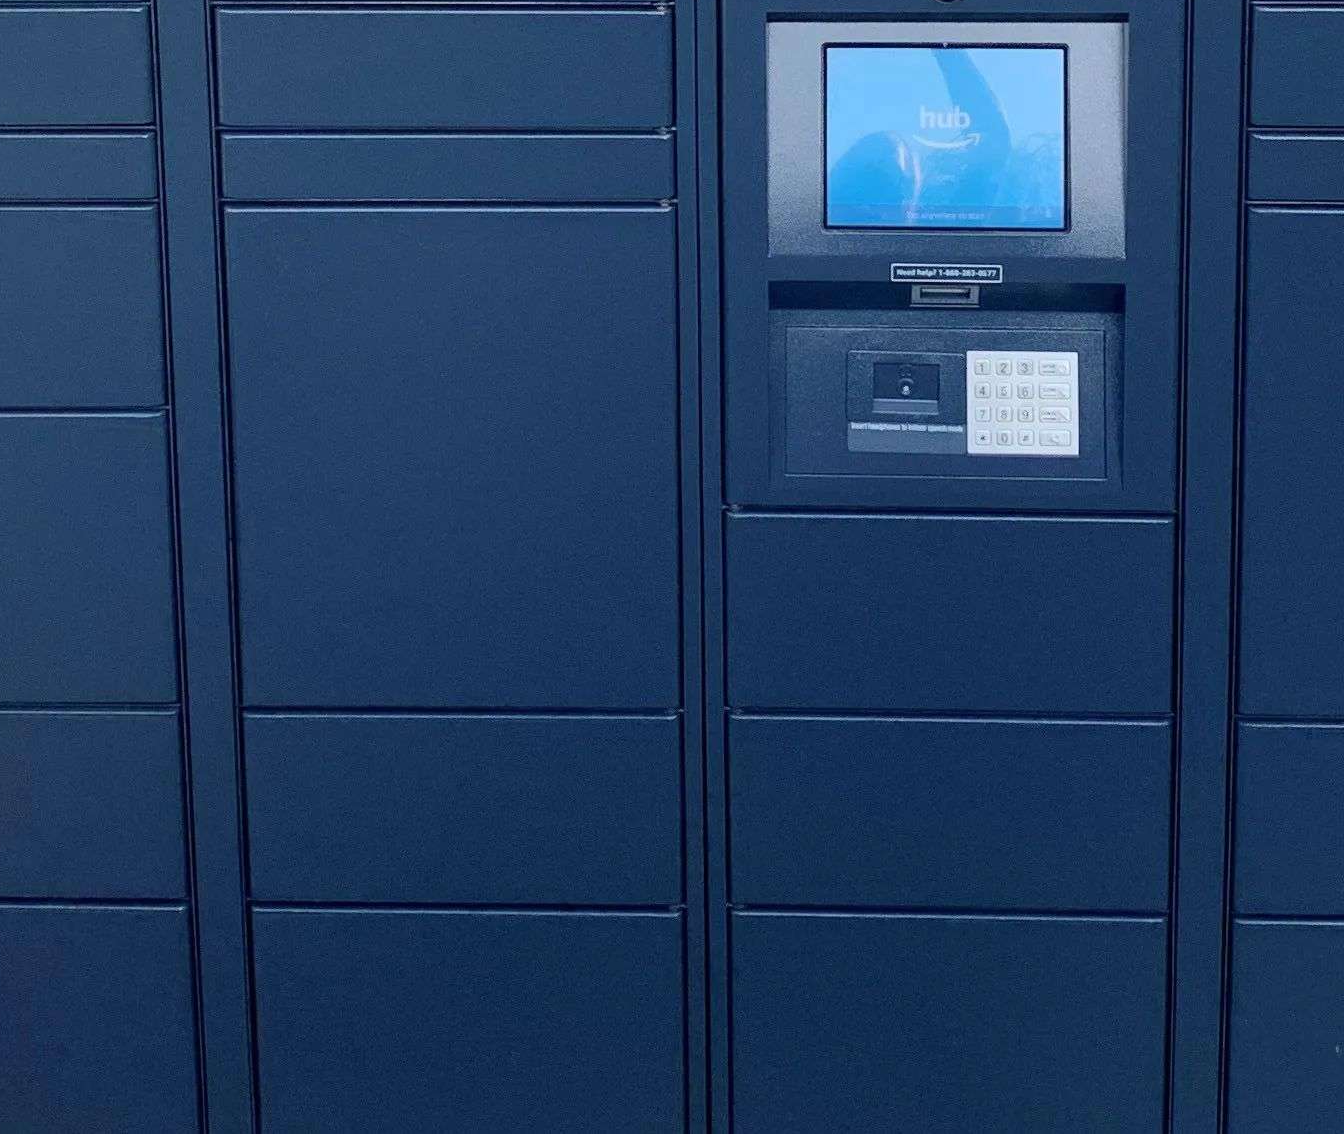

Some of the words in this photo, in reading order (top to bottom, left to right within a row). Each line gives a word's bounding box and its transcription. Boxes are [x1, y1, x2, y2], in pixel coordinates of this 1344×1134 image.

[919, 105, 971, 129] hub
[999, 362, 1008, 374] 2
[1020, 362, 1029, 374] 3
[978, 386, 987, 397] 4
[1021, 386, 1030, 398] 6
[1000, 409, 1008, 420] 8
[1000, 432, 1009, 444] 0
